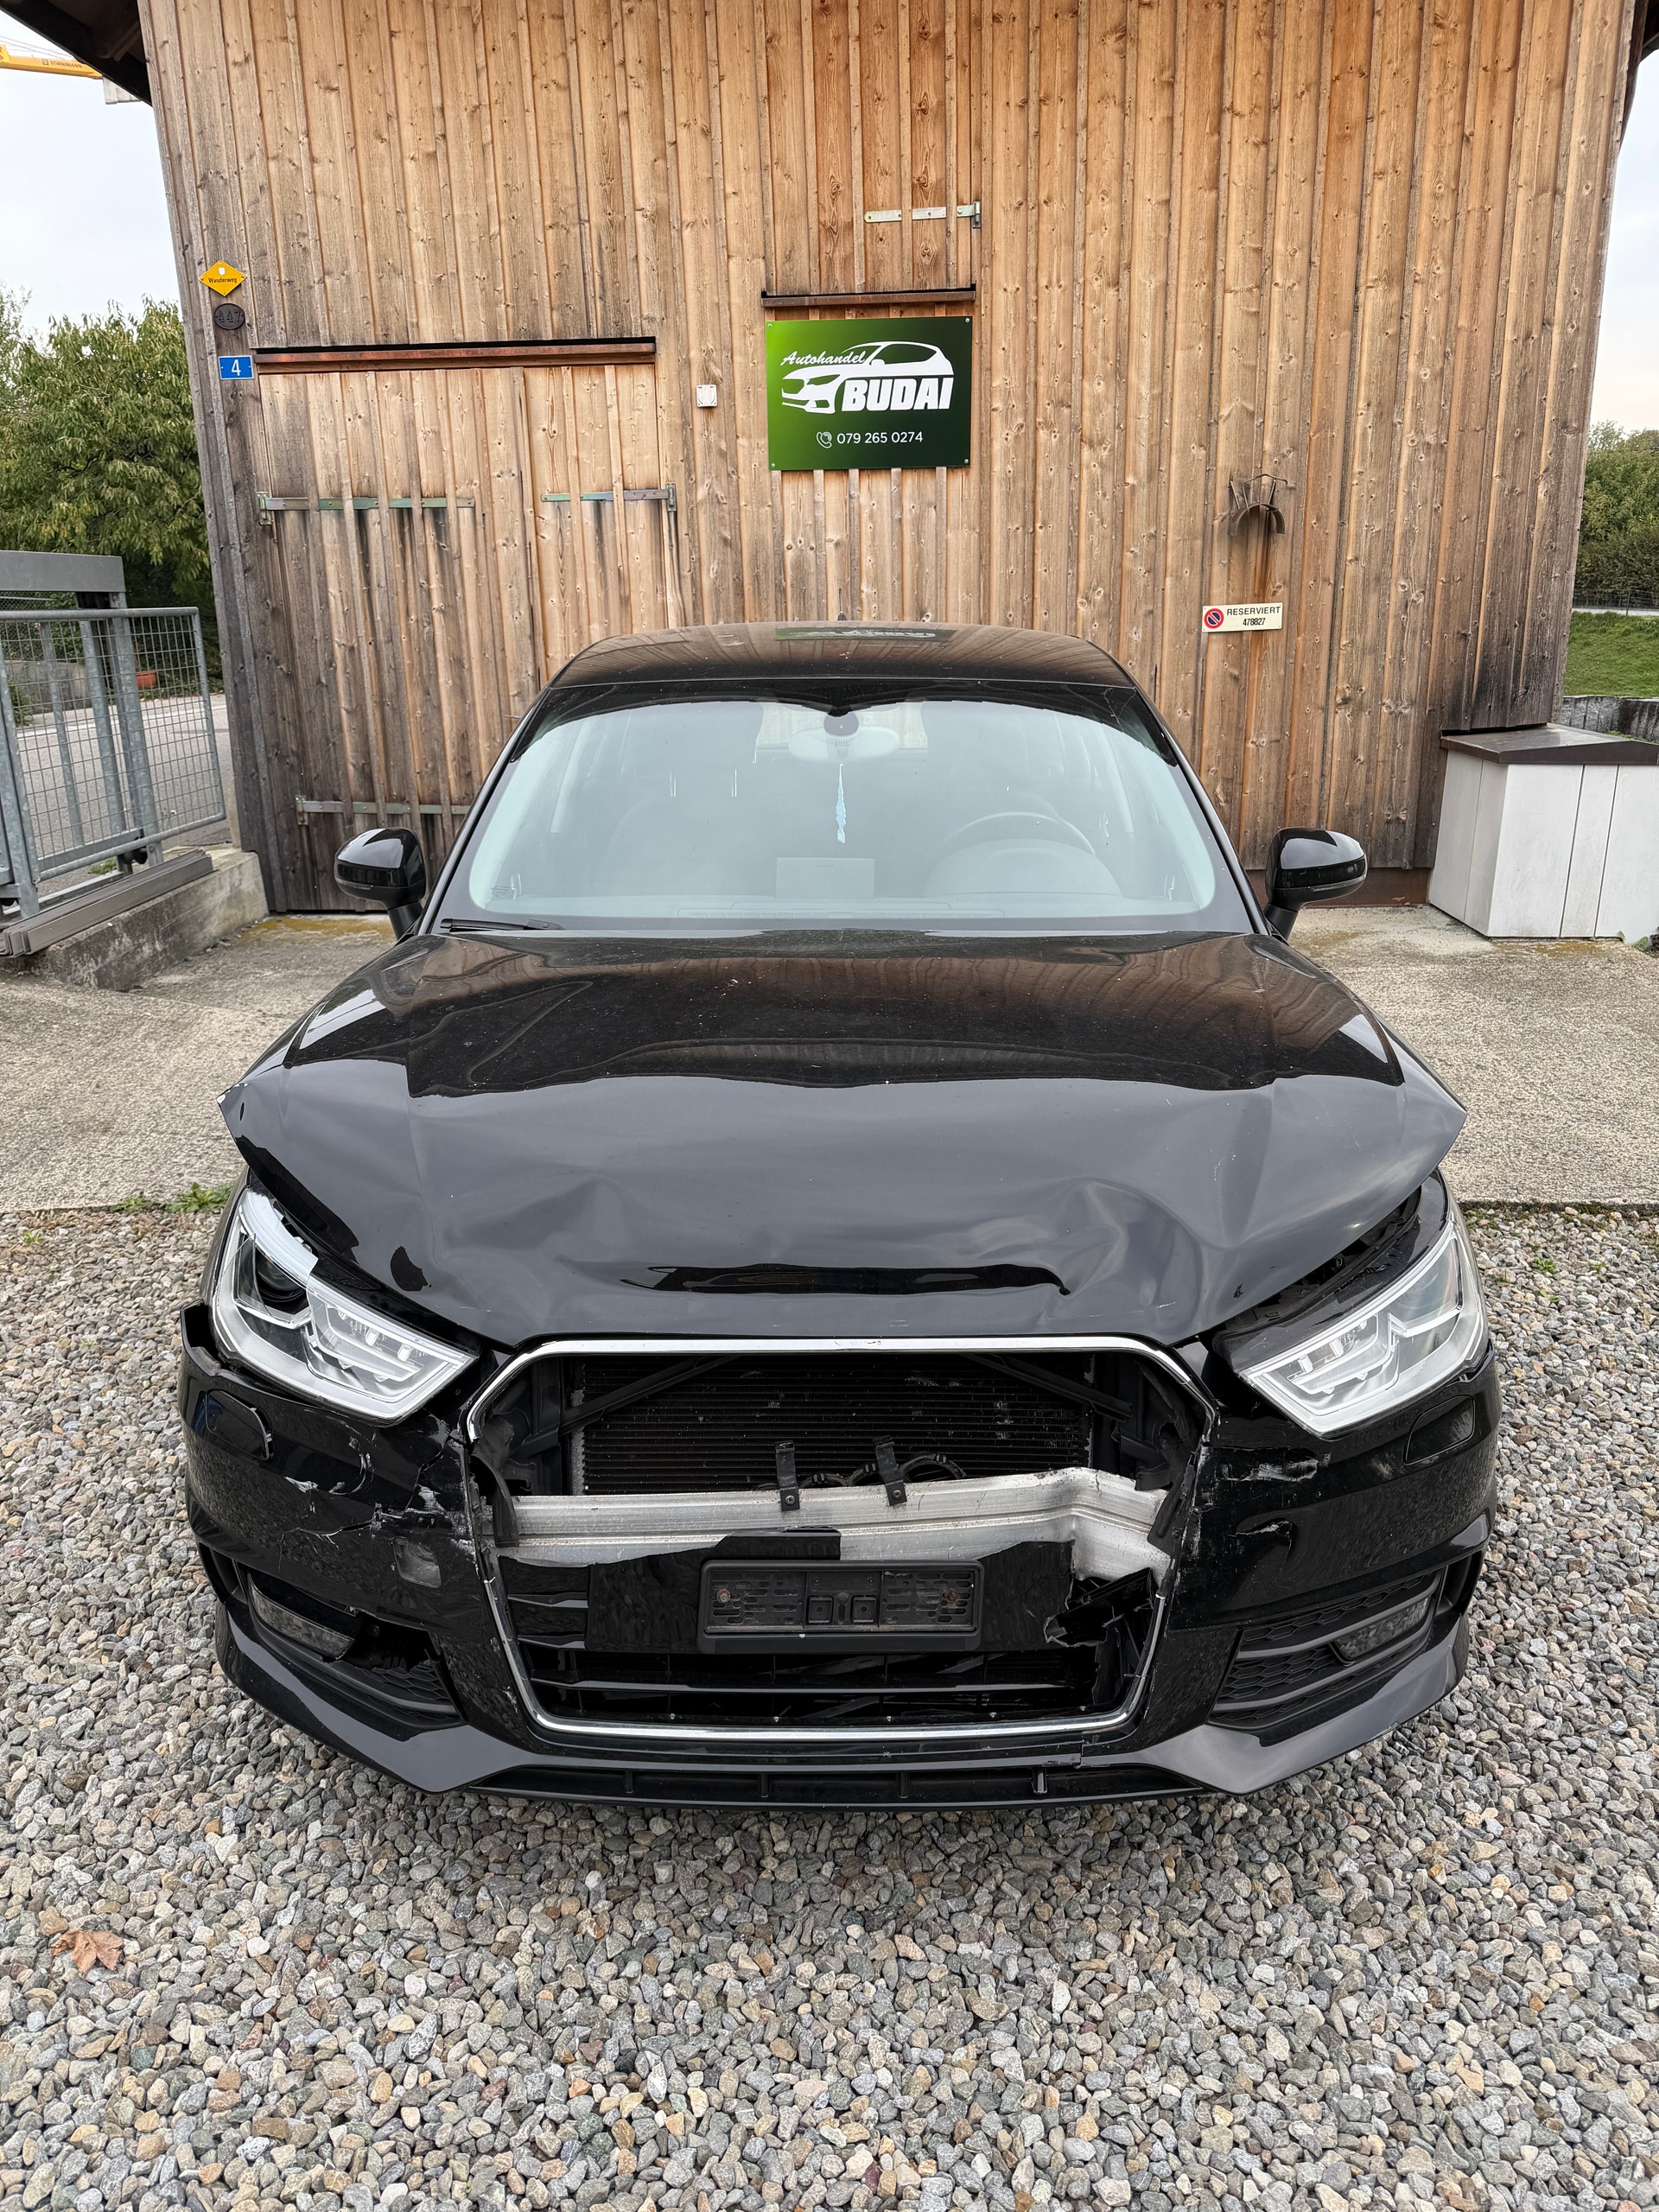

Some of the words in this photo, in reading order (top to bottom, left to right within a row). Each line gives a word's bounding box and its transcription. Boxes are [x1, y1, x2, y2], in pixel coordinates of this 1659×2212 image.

[780, 351, 867, 366] Autohandel
[231, 359, 241, 376] 4
[842, 378, 954, 411] BUDAI
[836, 433, 861, 444] 079
[864, 433, 888, 444] 265
[891, 432, 923, 443] 0274
[1227, 607, 1281, 615] RESERVIERT
